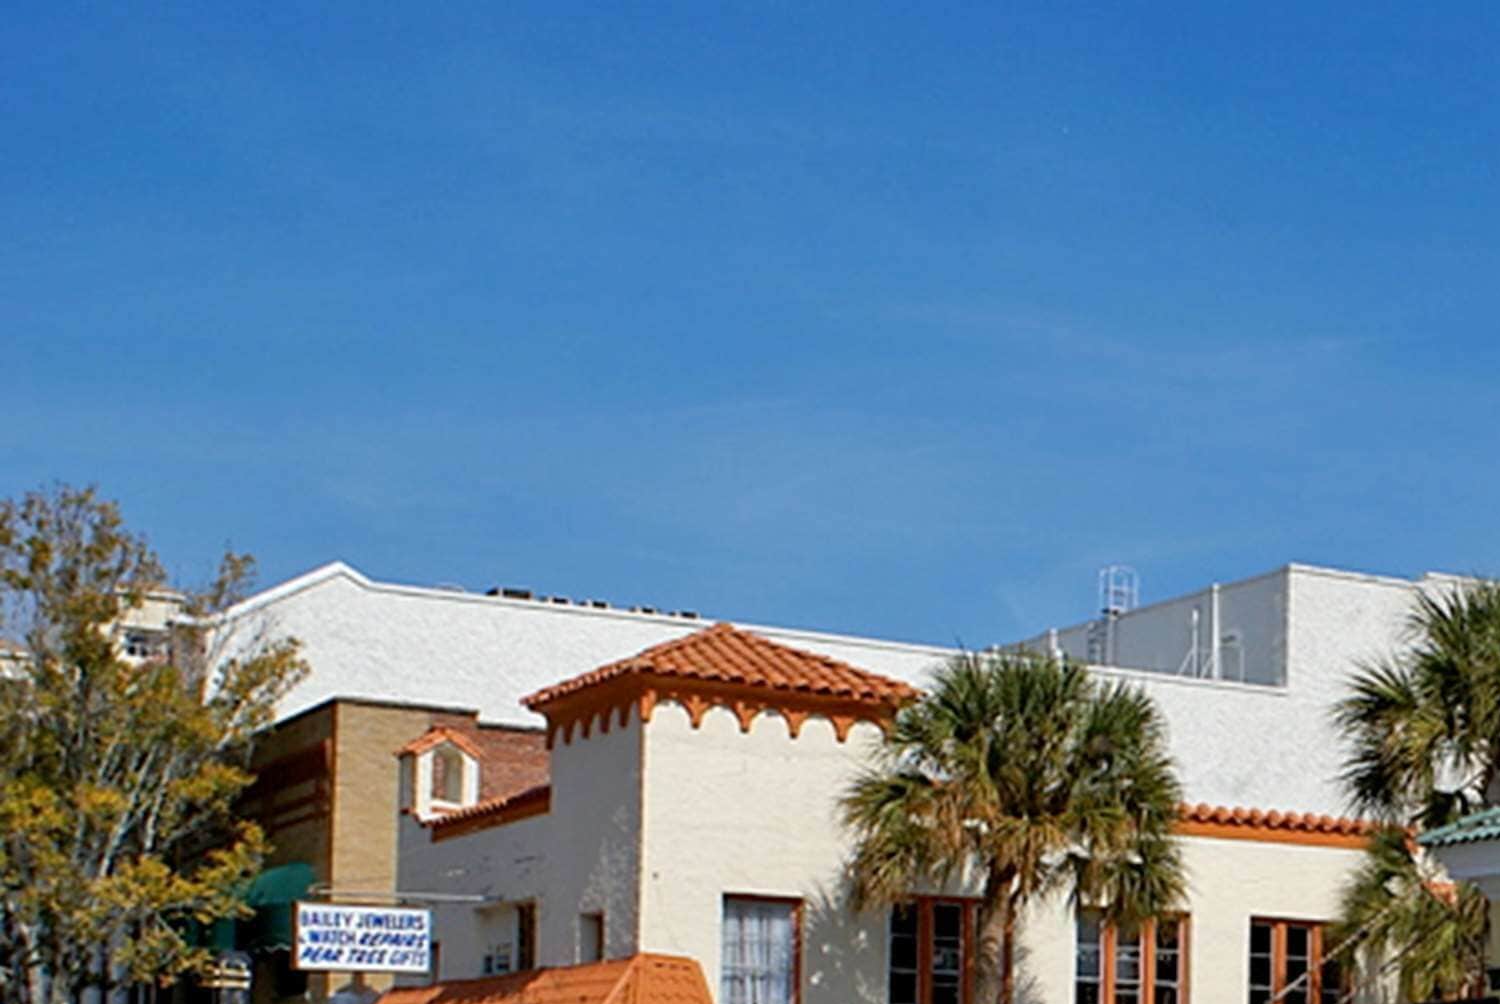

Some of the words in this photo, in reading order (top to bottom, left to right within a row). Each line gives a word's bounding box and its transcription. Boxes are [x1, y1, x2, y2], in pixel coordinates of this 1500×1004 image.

[301, 911, 354, 927] BAILEY
[356, 912, 424, 931] JEWELERS
[309, 930, 357, 944] WATCH
[358, 932, 428, 948] REPAIRS
[300, 946, 343, 962] PEAR
[346, 948, 388, 964] TREE
[388, 951, 426, 967] GIFTS
